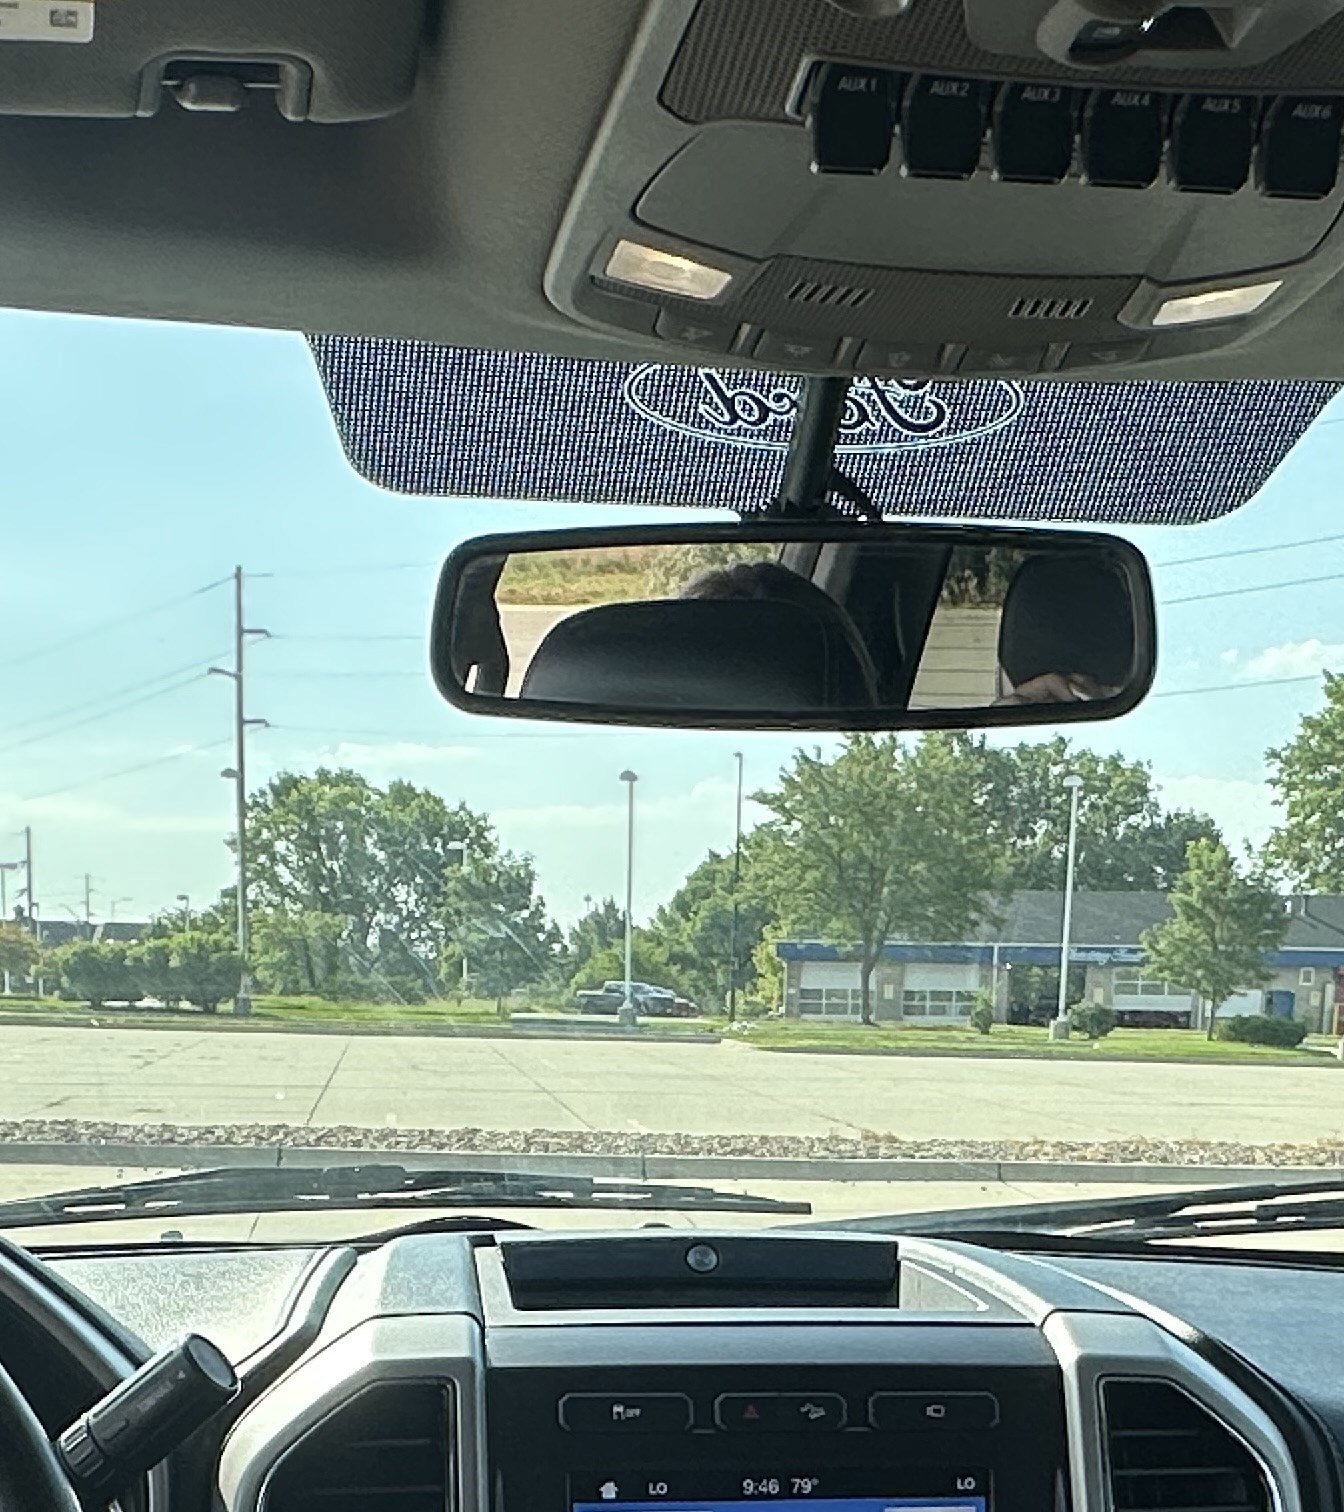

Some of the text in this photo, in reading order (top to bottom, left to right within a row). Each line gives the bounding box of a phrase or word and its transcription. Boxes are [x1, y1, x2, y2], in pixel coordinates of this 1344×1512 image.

[649, 1481, 668, 1496] LO
[742, 1478, 780, 1496] 9:46
[956, 1476, 976, 1490] LO
